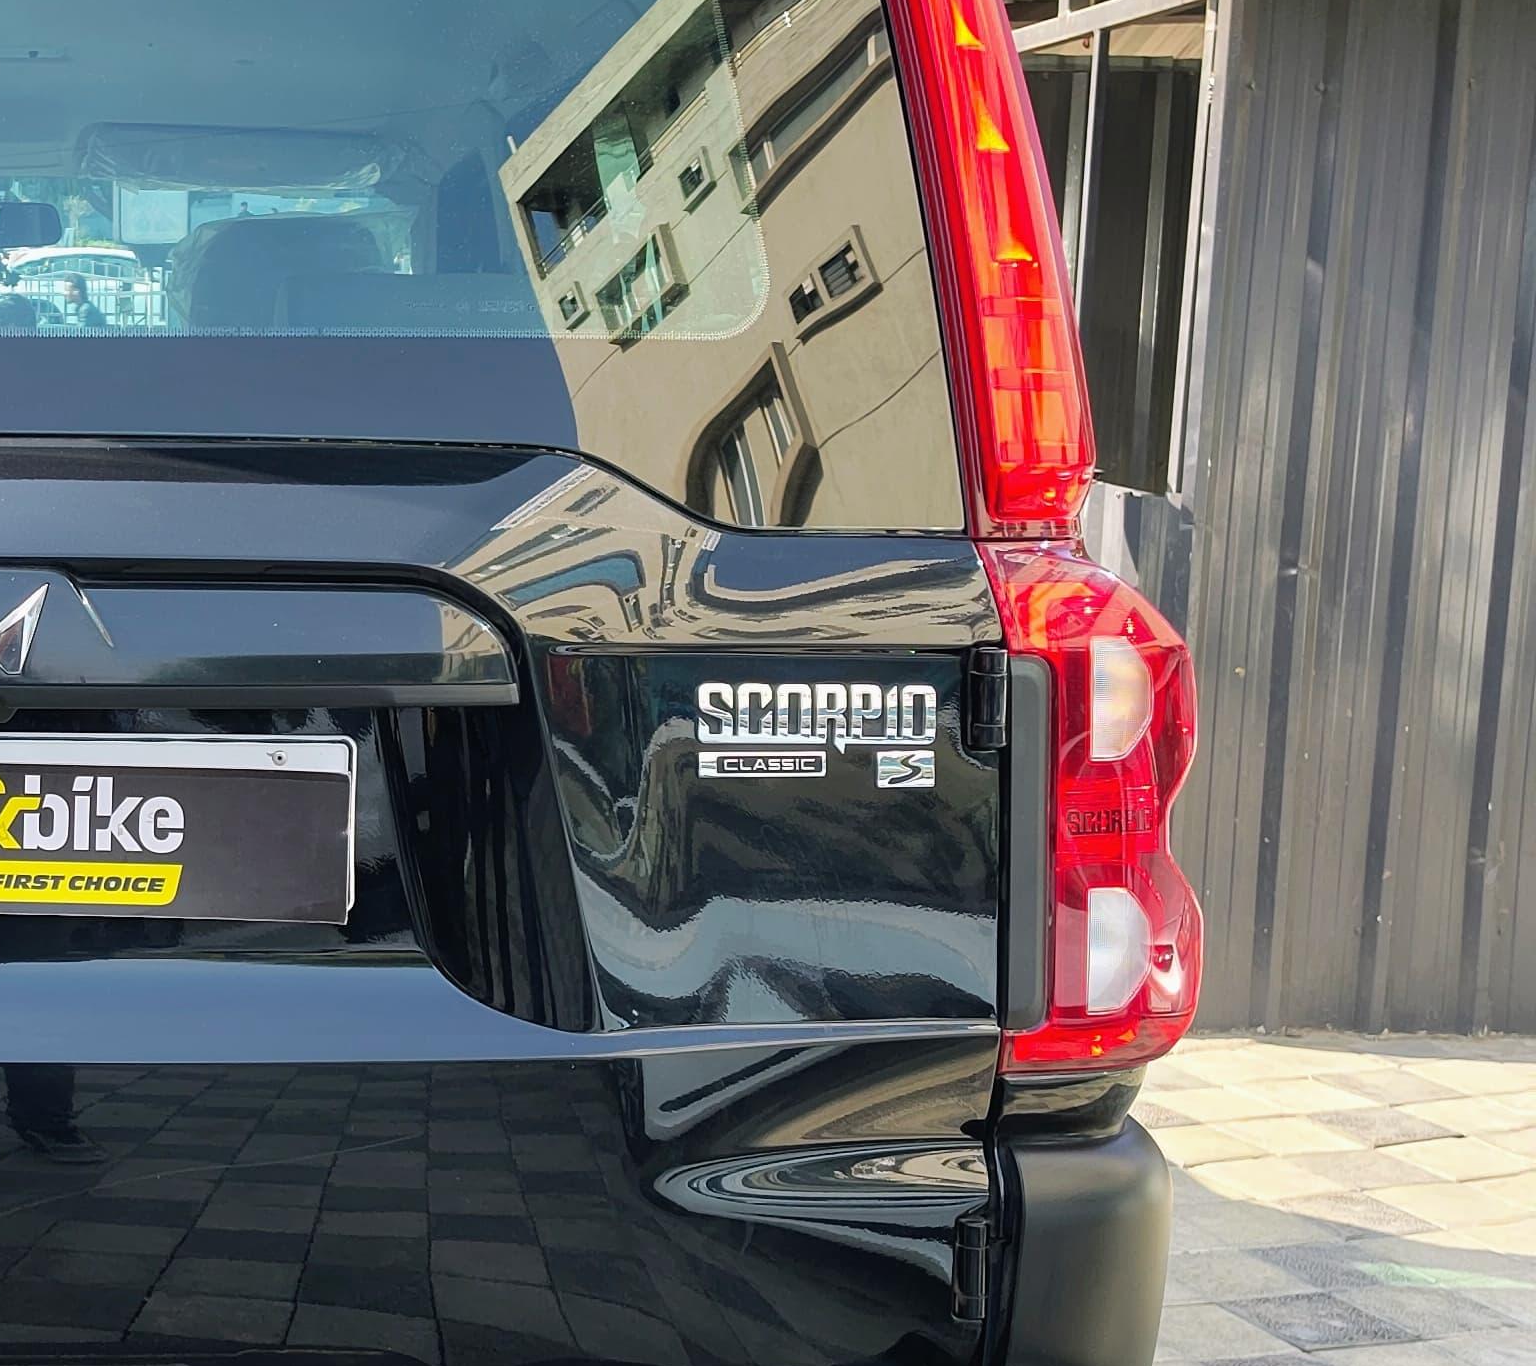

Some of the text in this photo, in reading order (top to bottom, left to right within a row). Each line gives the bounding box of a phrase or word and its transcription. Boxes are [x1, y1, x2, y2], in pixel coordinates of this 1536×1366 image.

[697, 682, 937, 754] SCORPIO
[723, 758, 816, 771] CLASSIC
[68, 875, 167, 893] CHOICE
